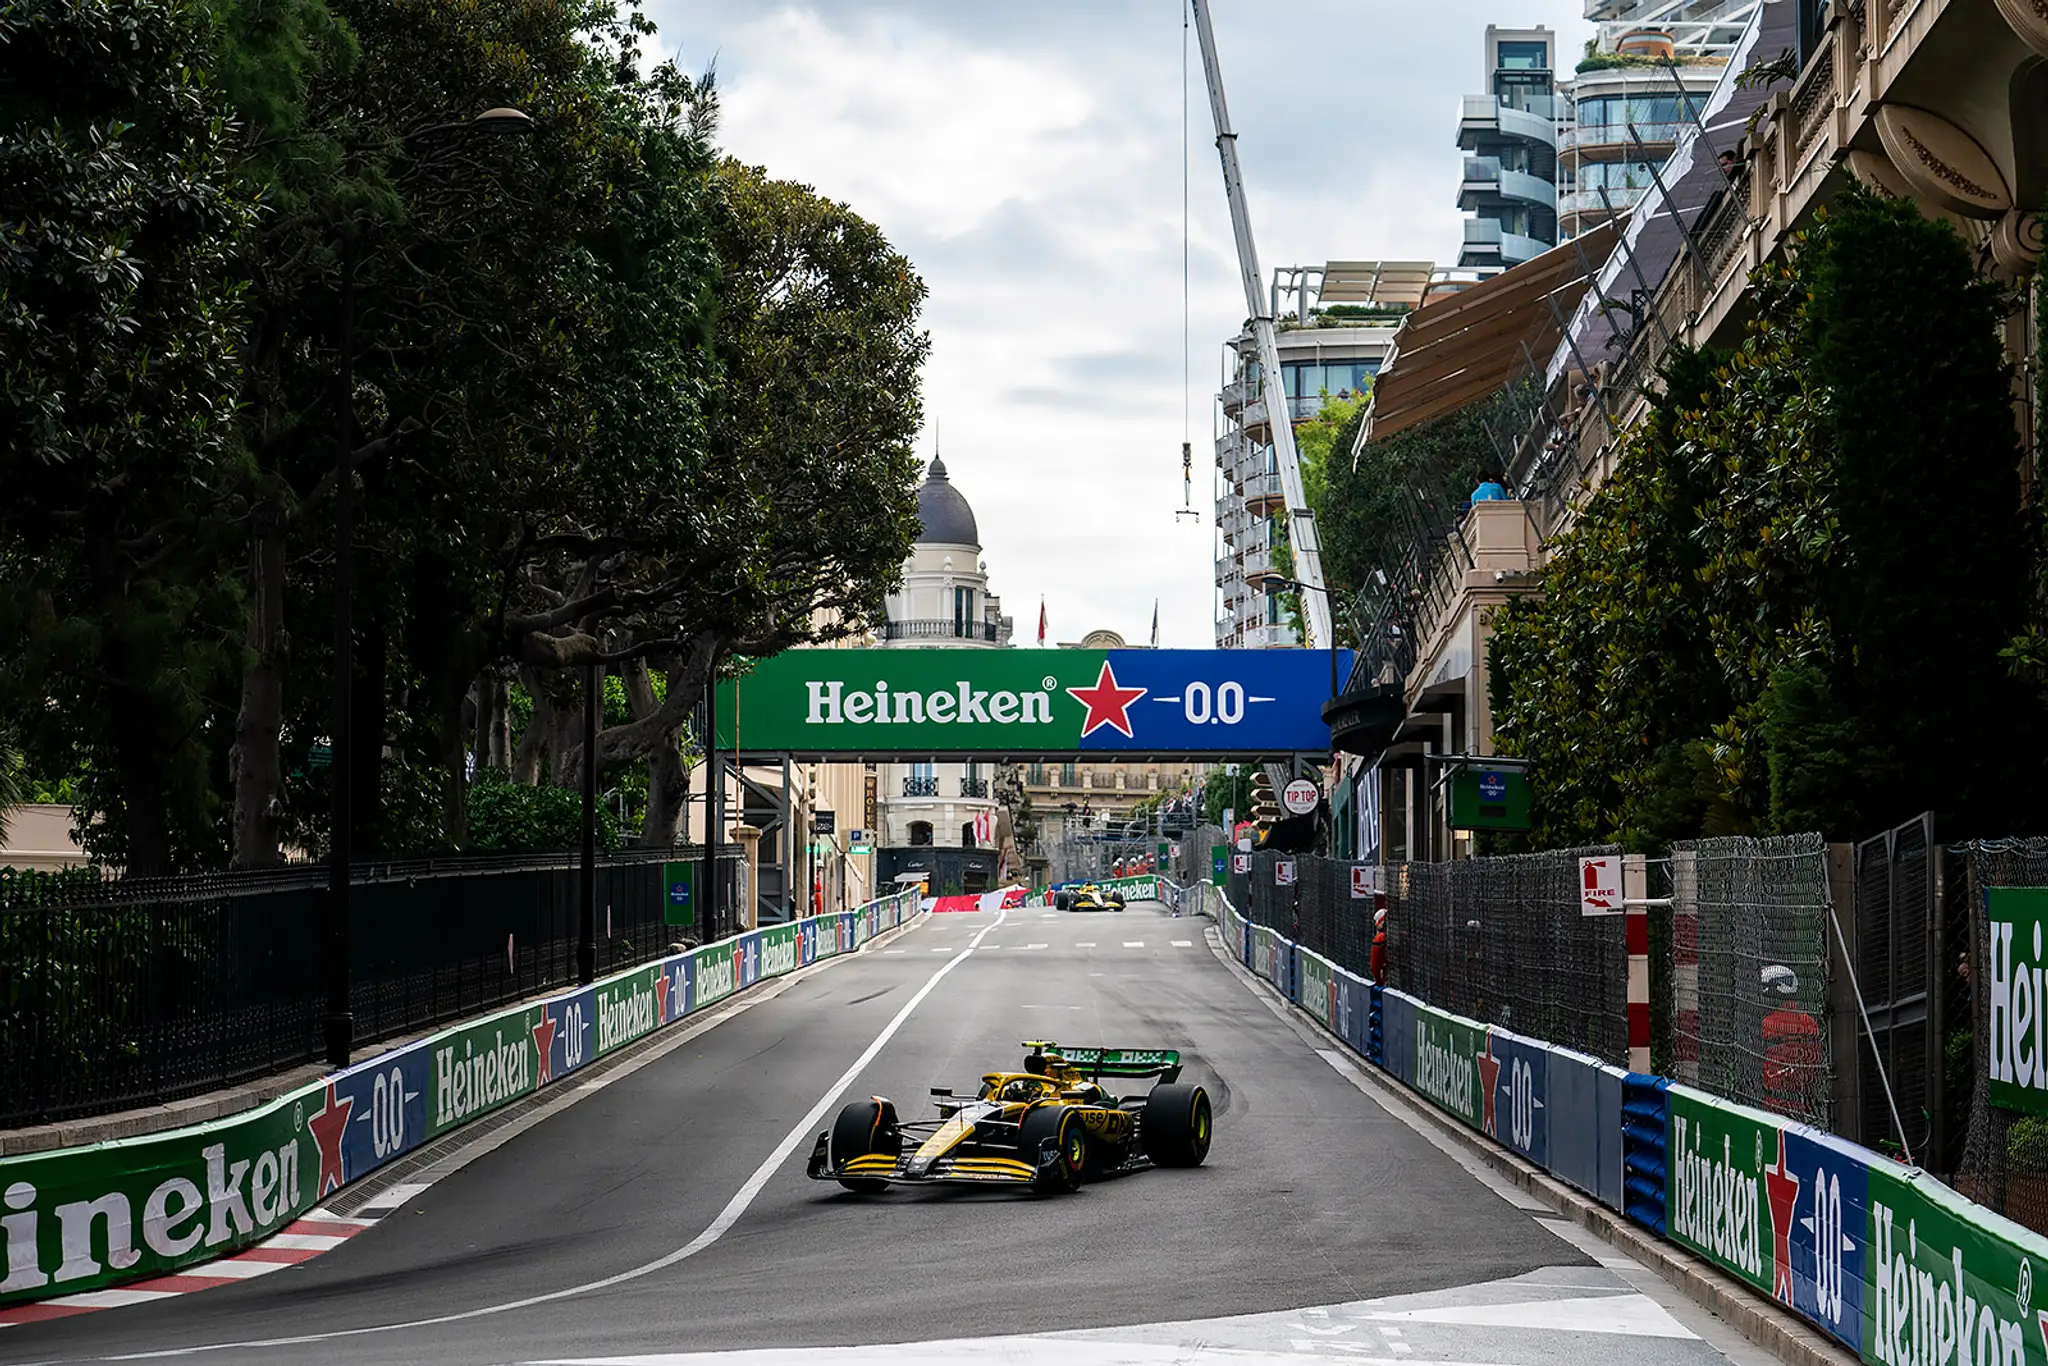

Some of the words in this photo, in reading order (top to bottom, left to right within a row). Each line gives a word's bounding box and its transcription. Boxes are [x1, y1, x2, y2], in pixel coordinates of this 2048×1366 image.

[1184, 681, 1244, 725] 0.0
[1286, 790, 1299, 803] TIP
[1301, 789, 1317, 803] TOP
[1584, 888, 1616, 897] FIRE
